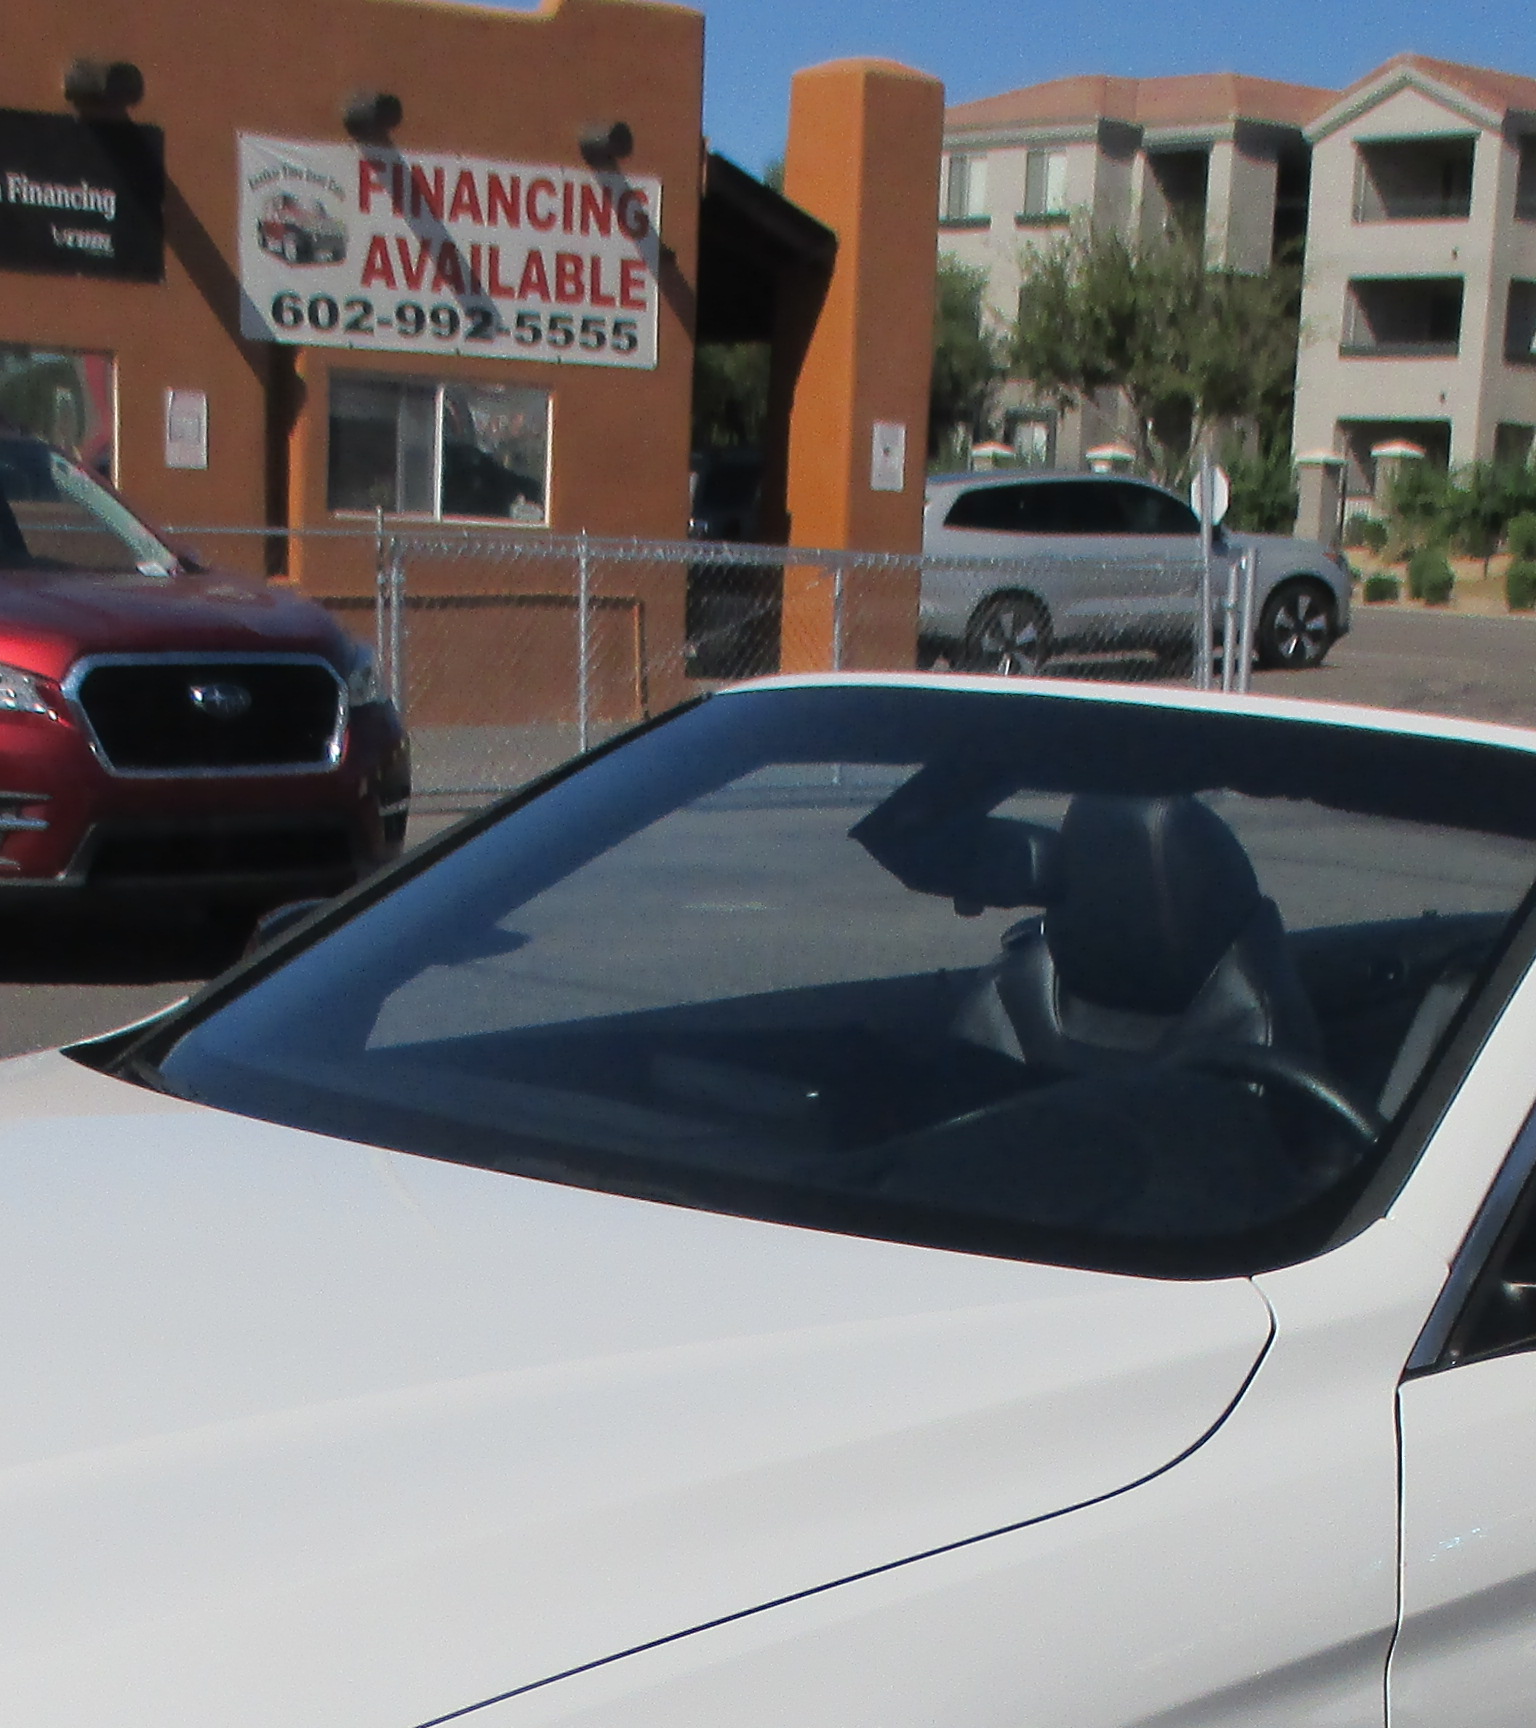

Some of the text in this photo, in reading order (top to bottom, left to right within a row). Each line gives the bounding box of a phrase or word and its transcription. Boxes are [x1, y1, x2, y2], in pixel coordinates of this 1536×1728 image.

[5, 171, 116, 222] Financing
[357, 159, 650, 241] FINANCING
[360, 235, 648, 311] AVAILABLE
[271, 290, 638, 355] 602-992-5555
